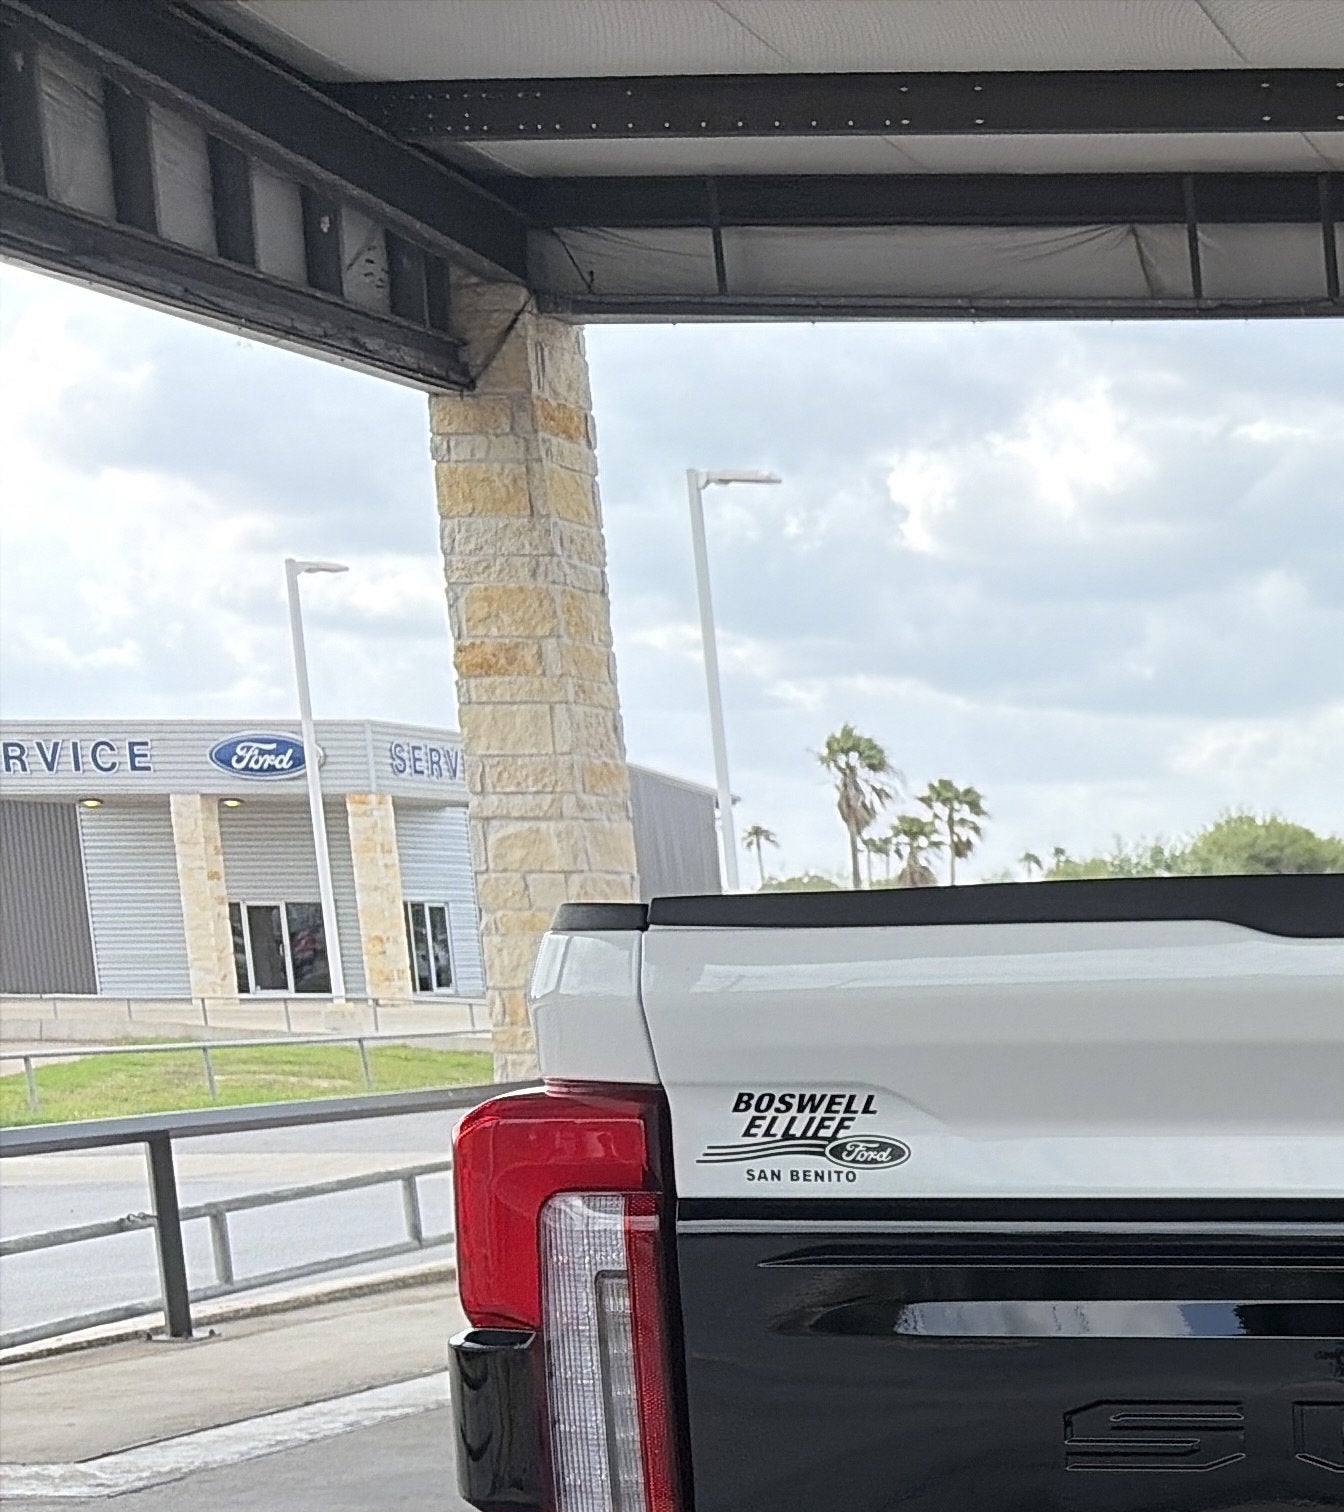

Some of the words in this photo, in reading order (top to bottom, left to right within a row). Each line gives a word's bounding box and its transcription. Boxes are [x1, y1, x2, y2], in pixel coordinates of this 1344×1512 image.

[230, 741, 294, 771] Ford
[391, 742, 464, 780] SERV
[732, 1092, 878, 1115] BOSWELL
[741, 1115, 856, 1139] ELLIFF
[842, 1142, 891, 1163] Ford
[746, 1168, 781, 1182] SAN
[790, 1169, 857, 1183] BENITO
